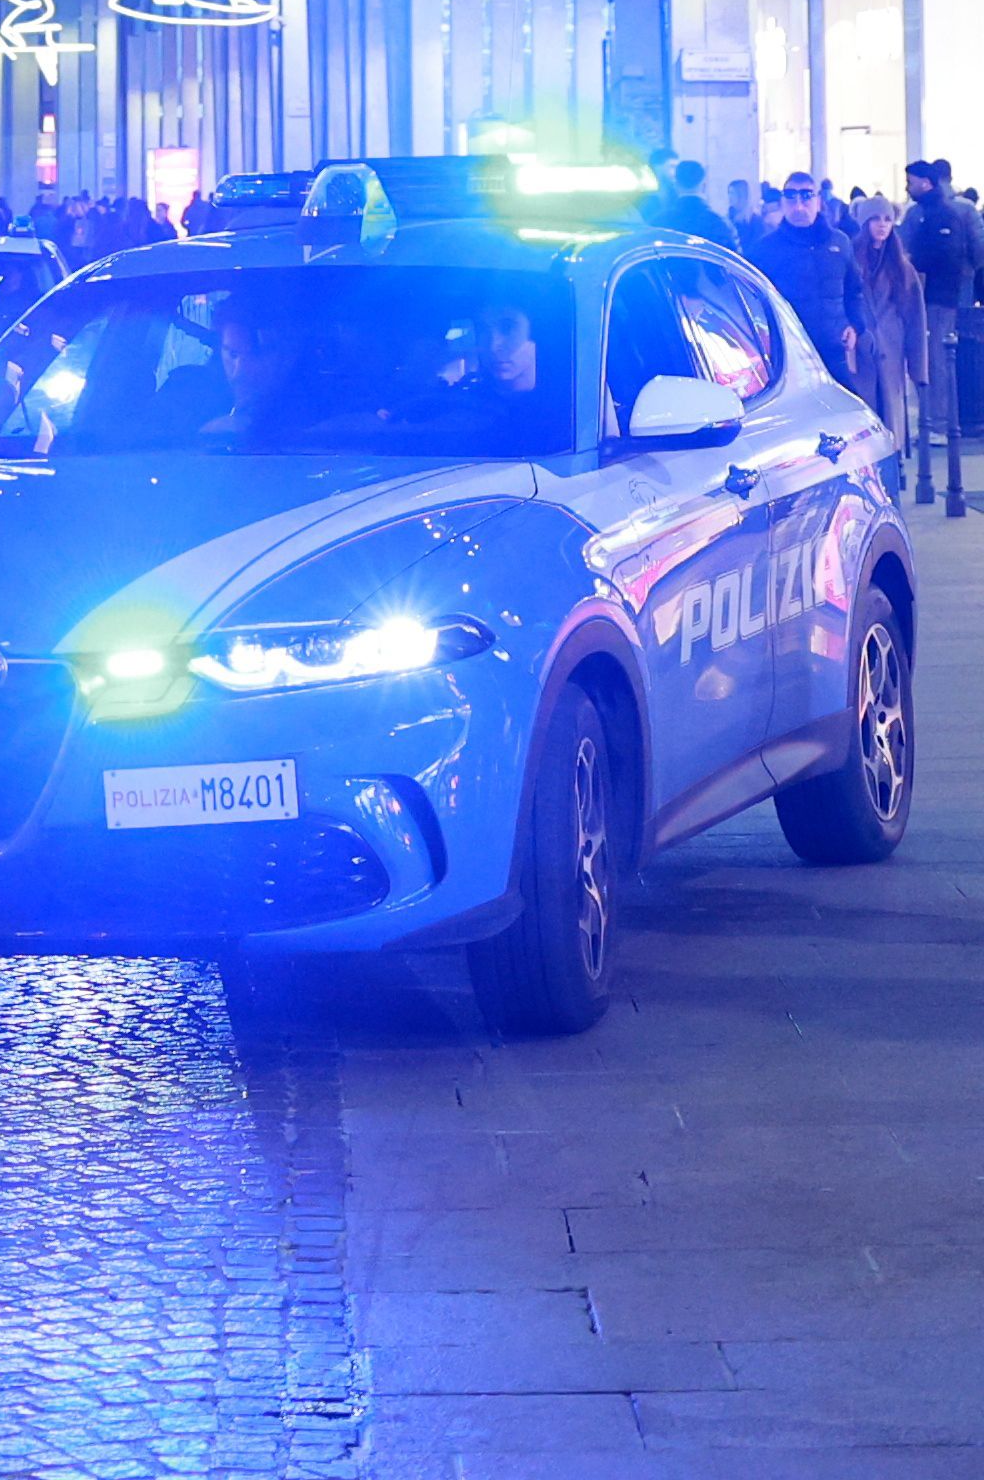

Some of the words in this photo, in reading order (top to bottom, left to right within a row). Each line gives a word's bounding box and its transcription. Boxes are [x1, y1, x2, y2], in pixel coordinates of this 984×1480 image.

[679, 532, 849, 668] POLIZIA
[112, 788, 192, 809] POLIZIA
[201, 773, 285, 812] M8401
